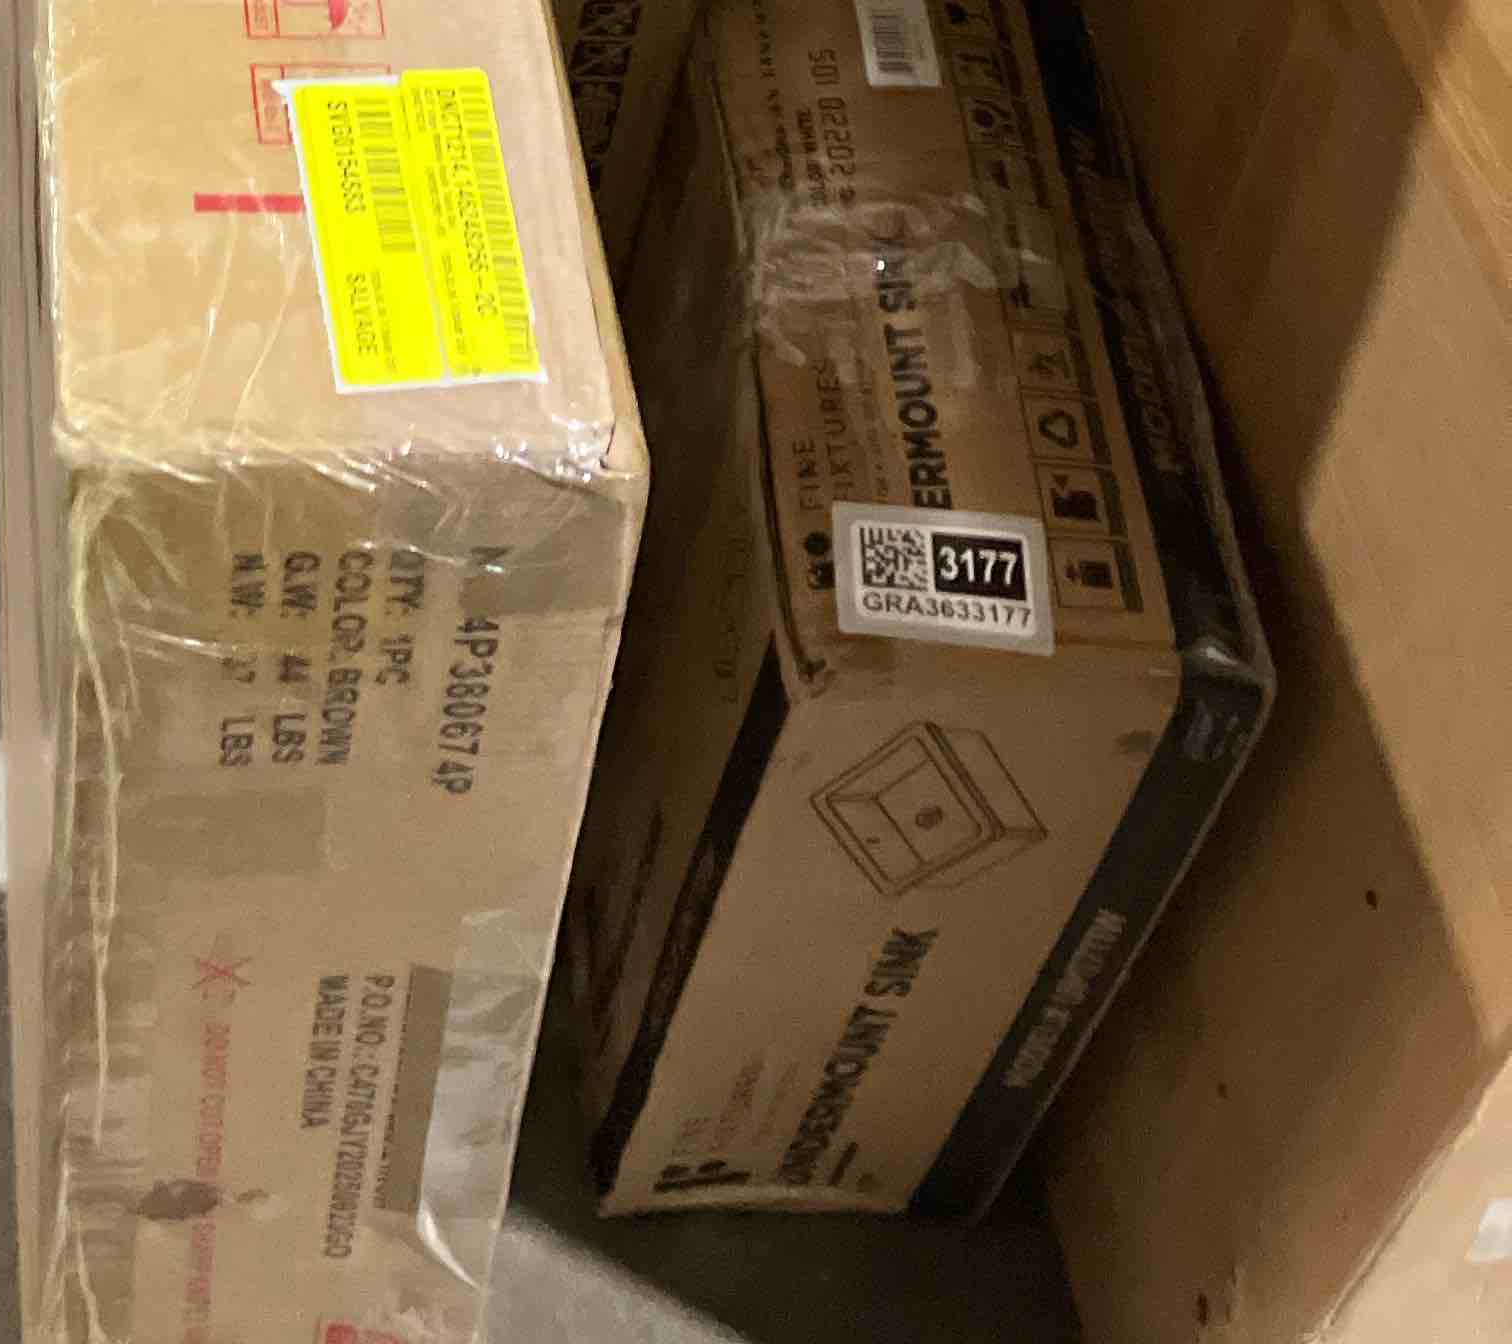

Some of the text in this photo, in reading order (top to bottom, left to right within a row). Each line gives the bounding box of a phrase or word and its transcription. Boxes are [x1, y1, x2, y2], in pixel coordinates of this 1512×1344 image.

[346, 272, 377, 355] SALVAGE
[819, 354, 851, 503] IXTURES
[940, 546, 1018, 586] 3177
[861, 591, 1032, 630] GRA3633177
[432, 545, 514, 796] N4P380674P
[219, 716, 255, 767] LBS
[271, 714, 307, 765] LBS
[315, 667, 362, 767] BROWN
[866, 926, 938, 996] SINK
[313, 975, 349, 1037] MADE
[300, 1069, 335, 1130] CHINA
